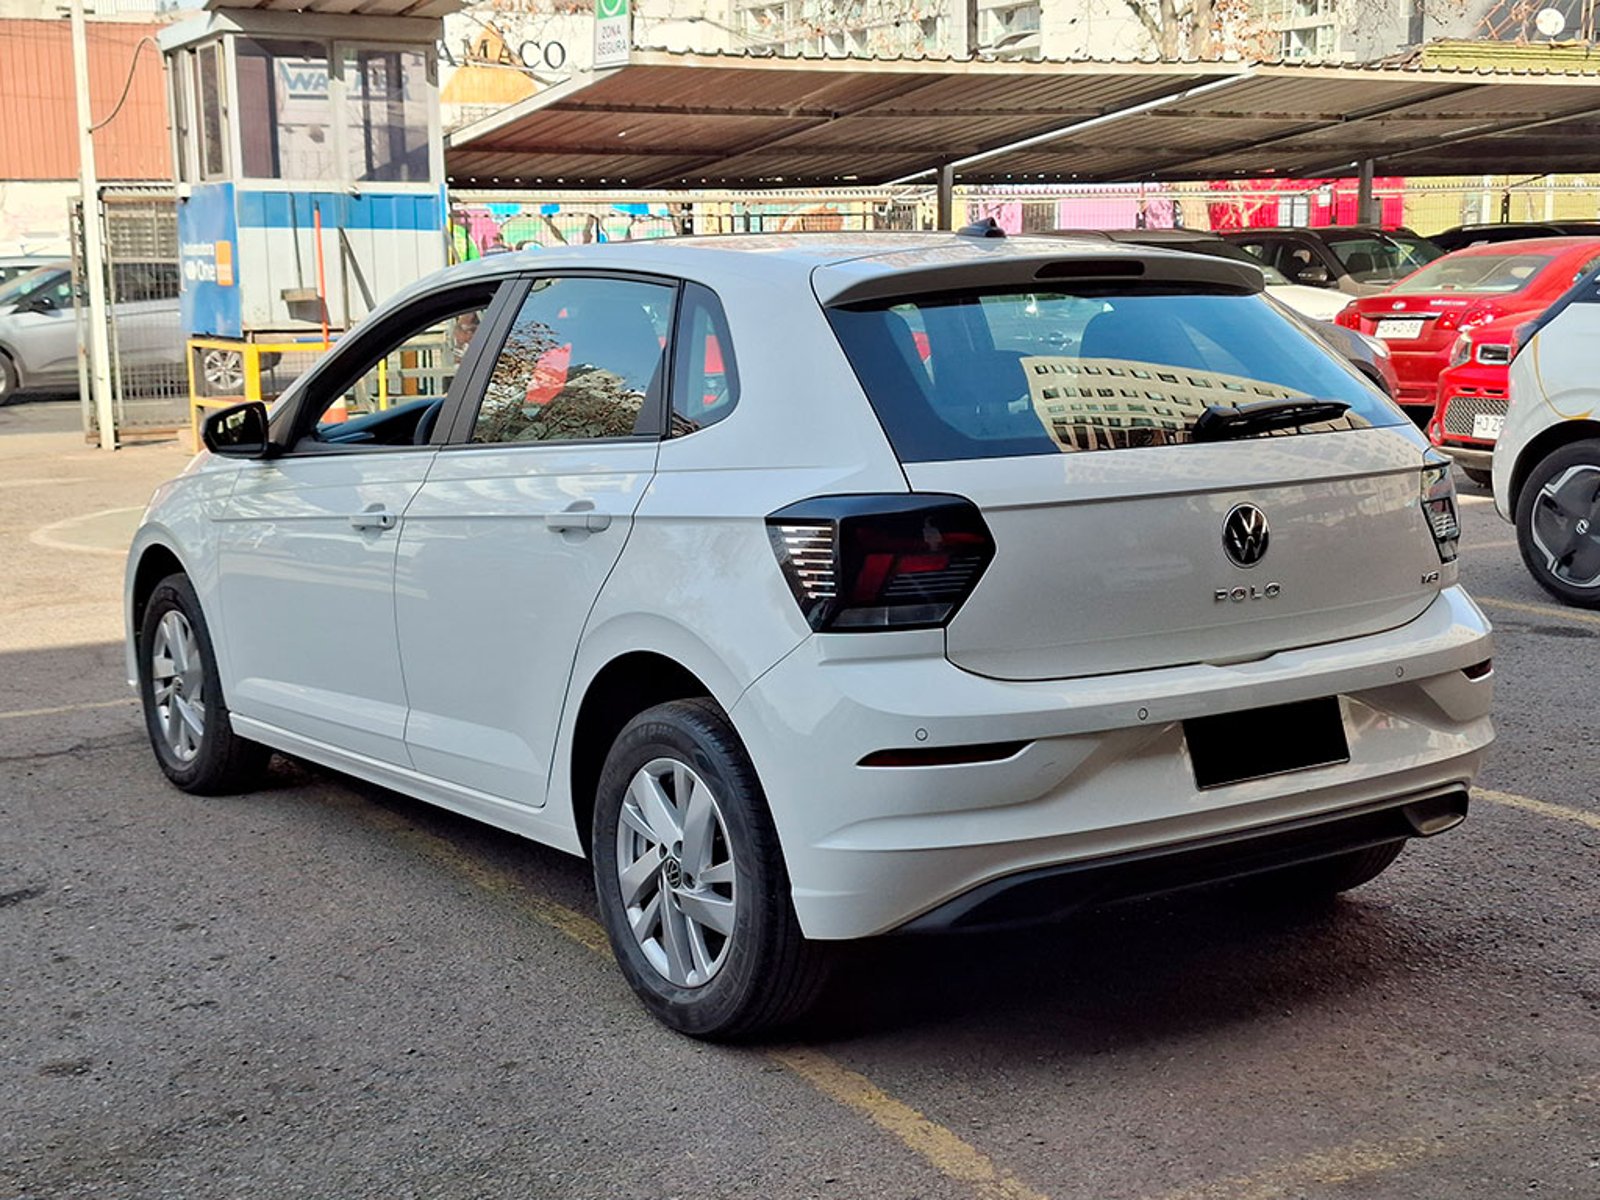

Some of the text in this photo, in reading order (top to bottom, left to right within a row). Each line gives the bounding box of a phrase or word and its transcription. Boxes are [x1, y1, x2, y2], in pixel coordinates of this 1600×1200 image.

[601, 24, 622, 39] ZONA
[597, 39, 628, 56] SEGURA
[1214, 582, 1280, 602] POLO
